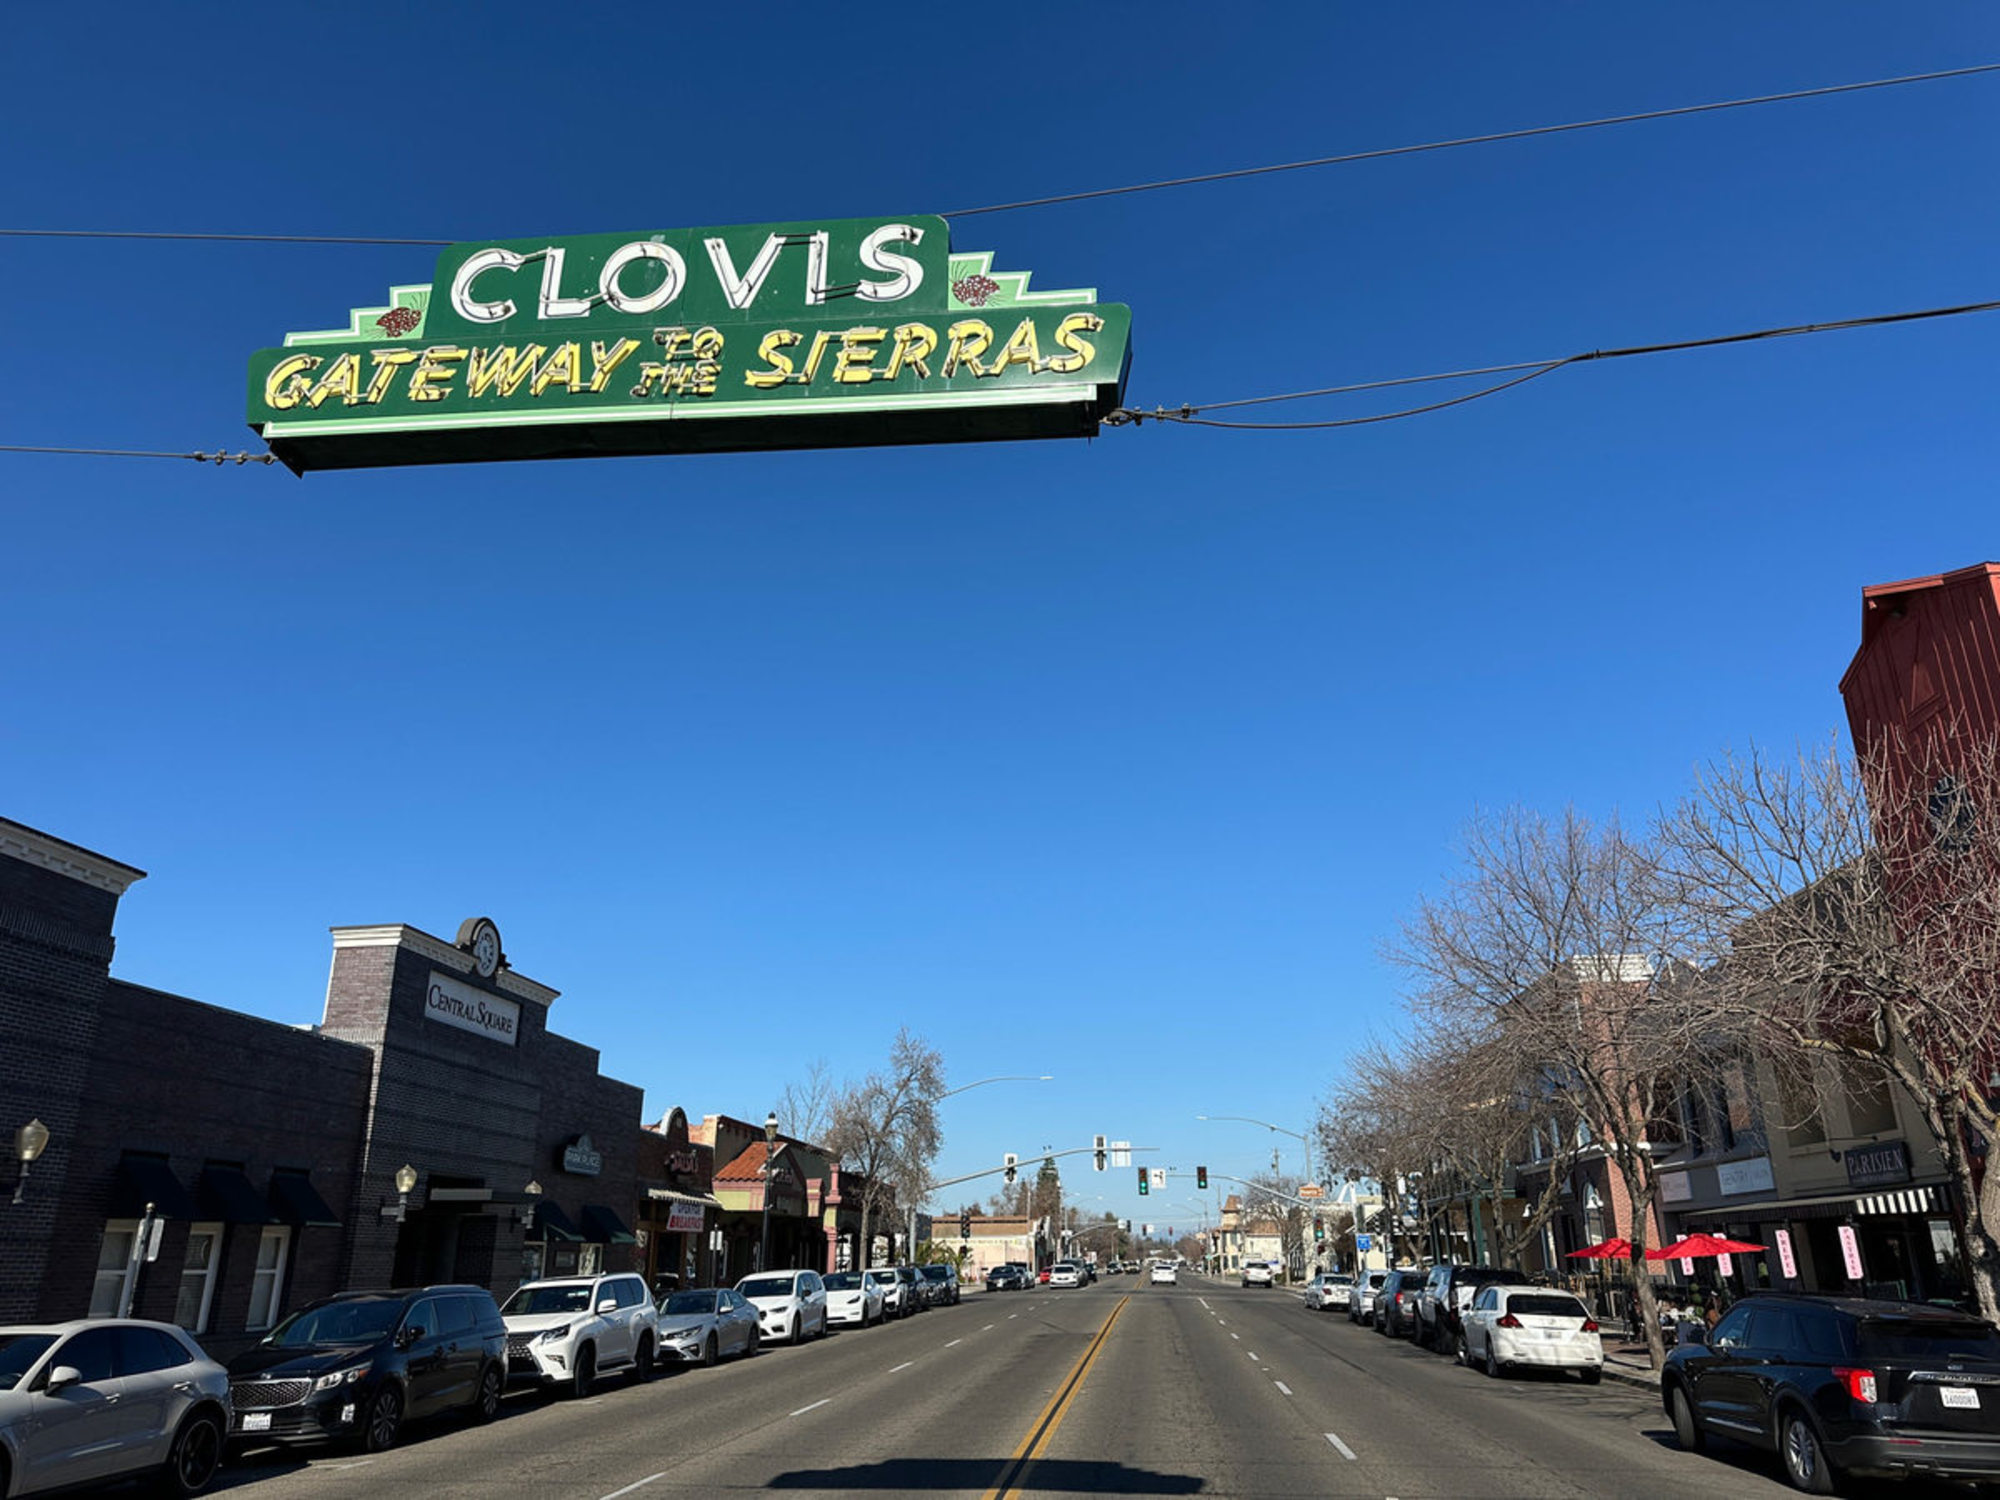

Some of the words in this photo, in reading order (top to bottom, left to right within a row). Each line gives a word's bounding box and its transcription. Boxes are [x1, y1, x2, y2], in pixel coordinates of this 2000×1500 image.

[450, 224, 926, 322] CLOVIS
[653, 326, 724, 361] TO
[744, 312, 1106, 388] SIERRAS
[263, 336, 640, 411] GATEWAY
[630, 362, 722, 397] THE
[1848, 1148, 1904, 1175] PARISIEN
